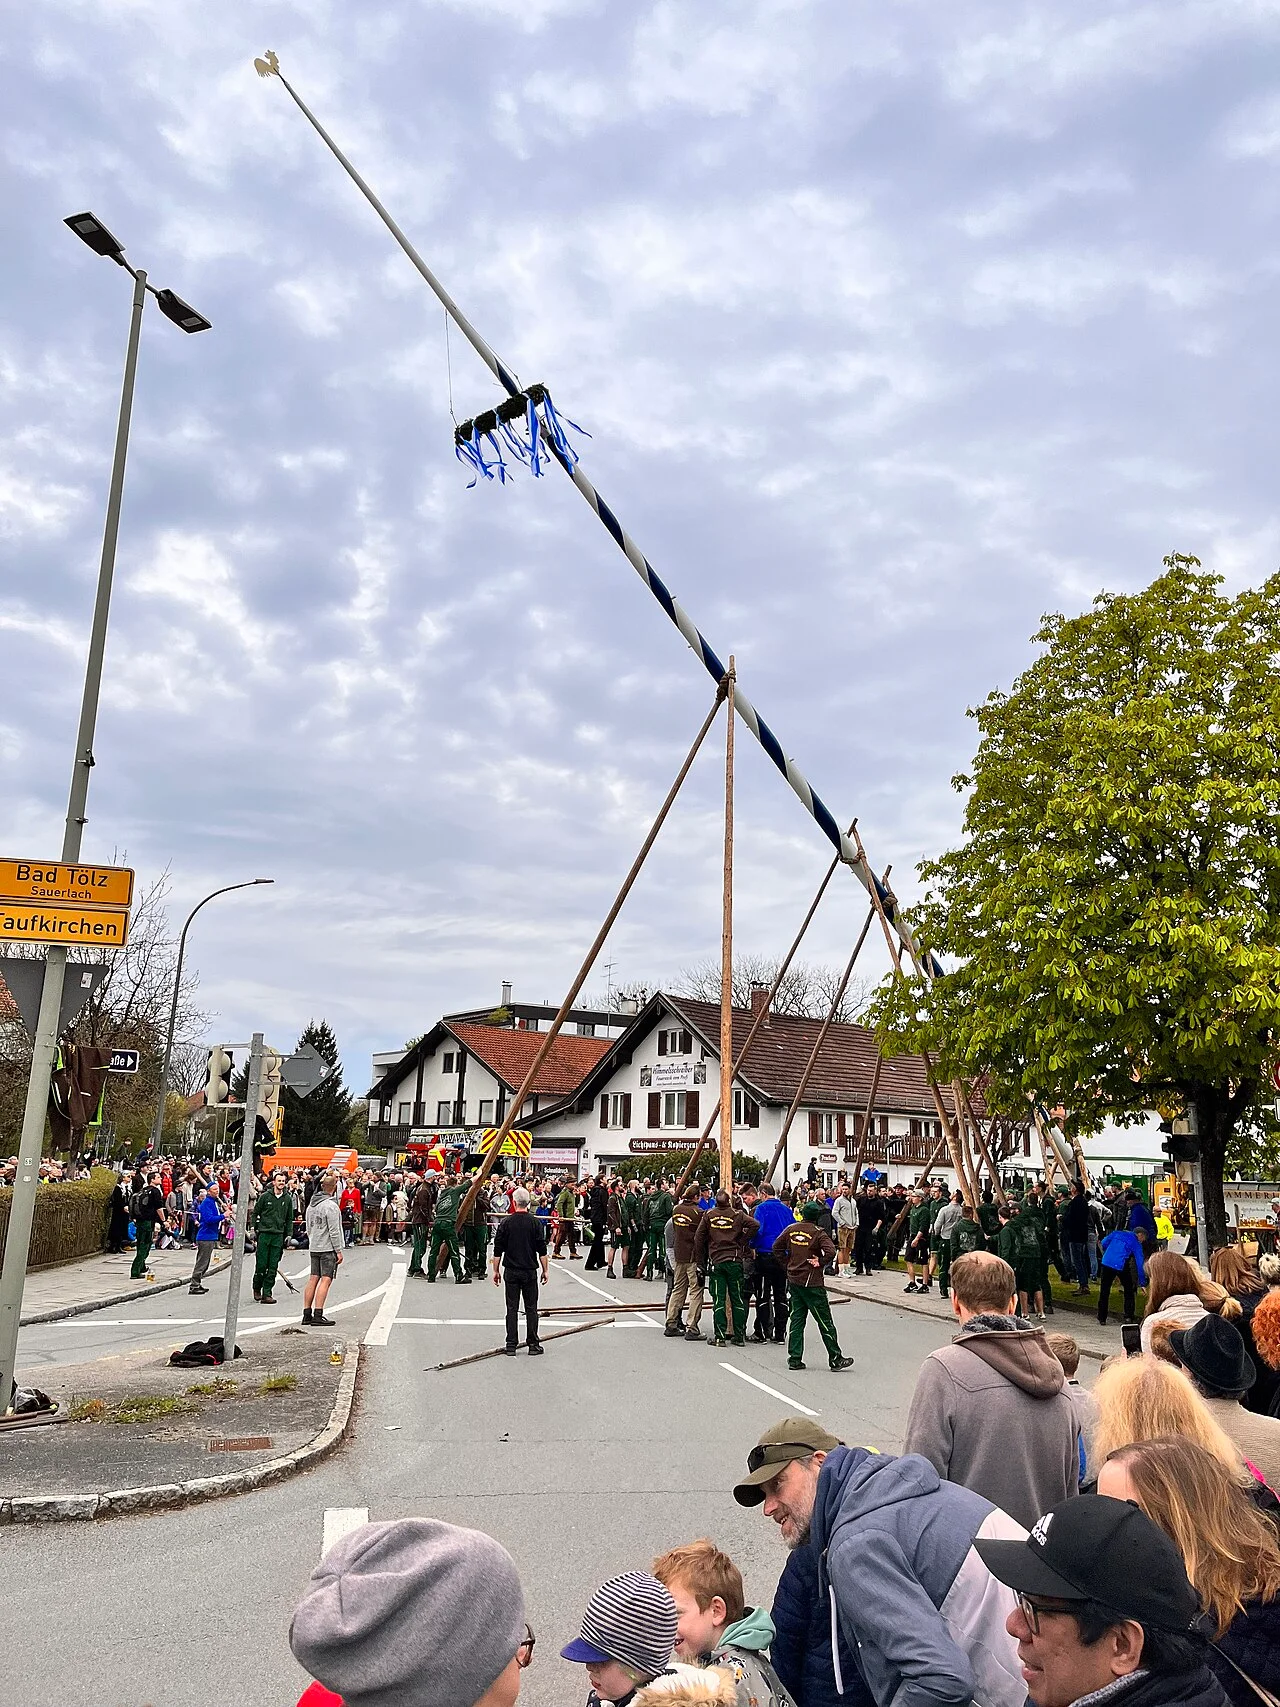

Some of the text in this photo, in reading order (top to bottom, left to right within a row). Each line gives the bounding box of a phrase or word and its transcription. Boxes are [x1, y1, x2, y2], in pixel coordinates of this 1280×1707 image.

[16, 864, 109, 887] Bad Tölz
[30, 886, 92, 899] Sauerlach
